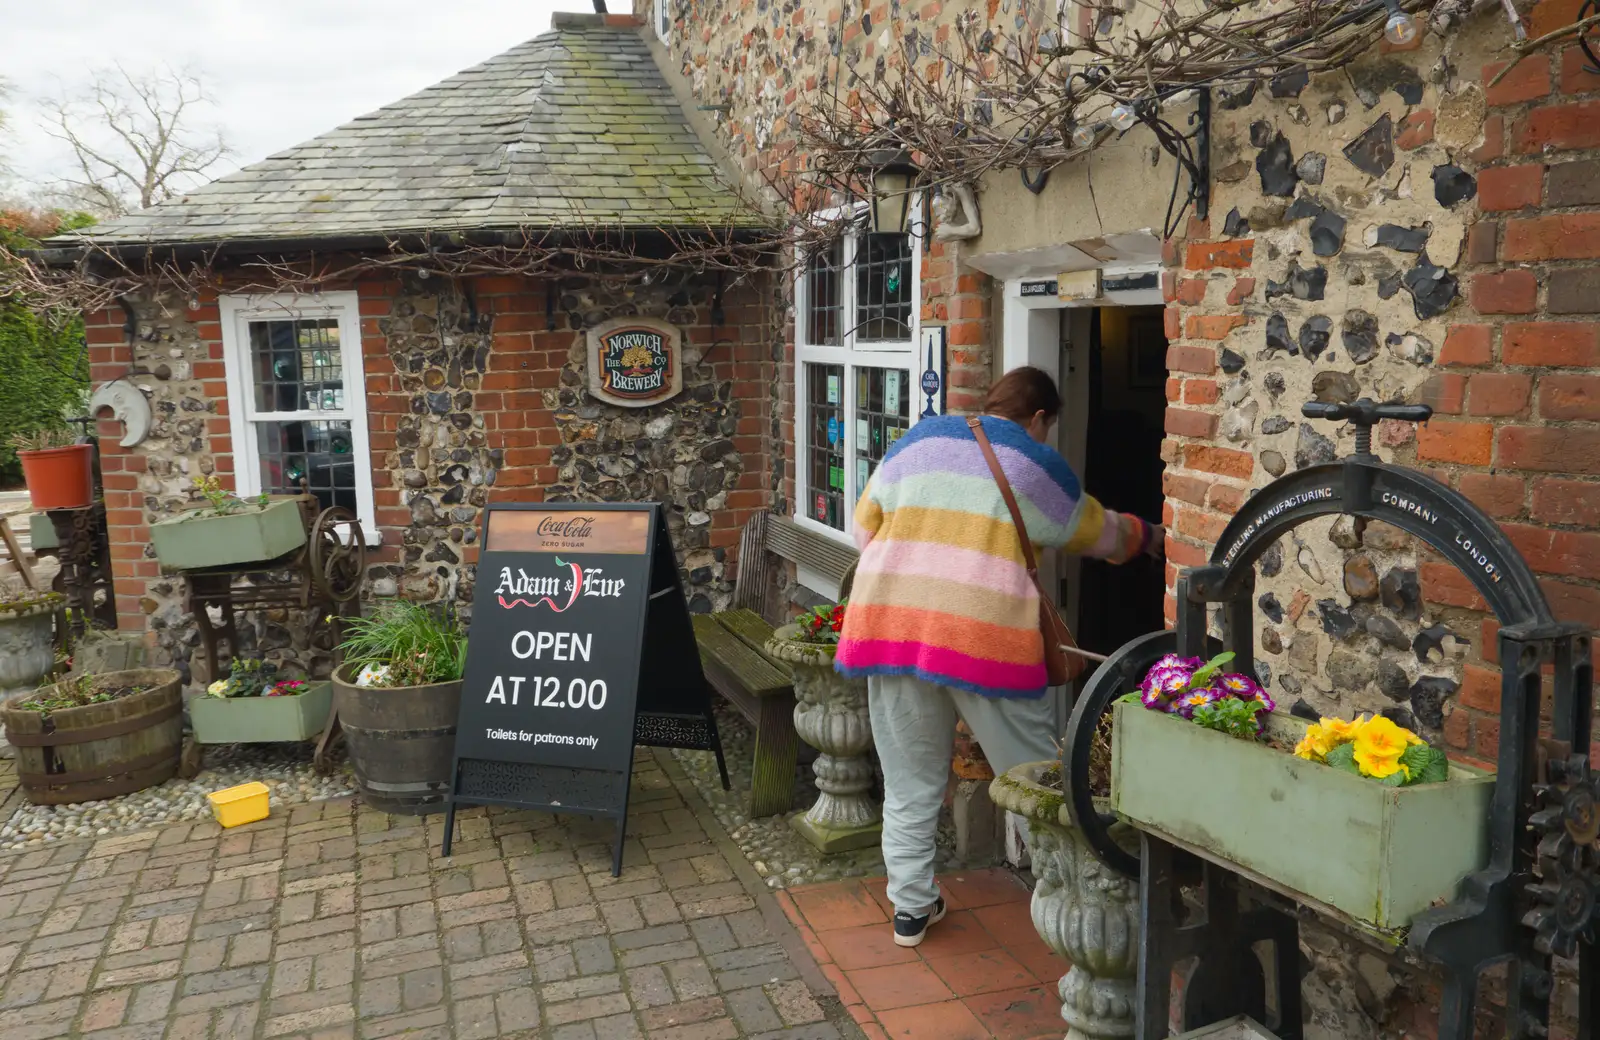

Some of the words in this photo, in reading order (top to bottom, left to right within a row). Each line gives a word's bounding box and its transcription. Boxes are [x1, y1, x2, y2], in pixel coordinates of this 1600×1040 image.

[609, 333, 662, 357] NORWICH
[605, 358, 621, 368] THE
[611, 367, 663, 391] BREWERY
[1222, 525, 1255, 568] STERLING
[1255, 487, 1332, 527] MANUFACTURING
[1382, 492, 1439, 525] COMPANY
[1455, 530, 1501, 583] LONDON
[561, 541, 585, 549] SUGAR
[493, 566, 560, 597] Adam
[564, 579, 574, 592] &
[582, 567, 626, 598] Eve
[511, 630, 593, 662] OPEN
[485, 675, 526, 706] AT
[533, 676, 608, 710] 12.00
[486, 728, 518, 741] Toilets
[519, 730, 534, 742] for
[534, 733, 575, 746] patrons
[576, 735, 599, 750] only
